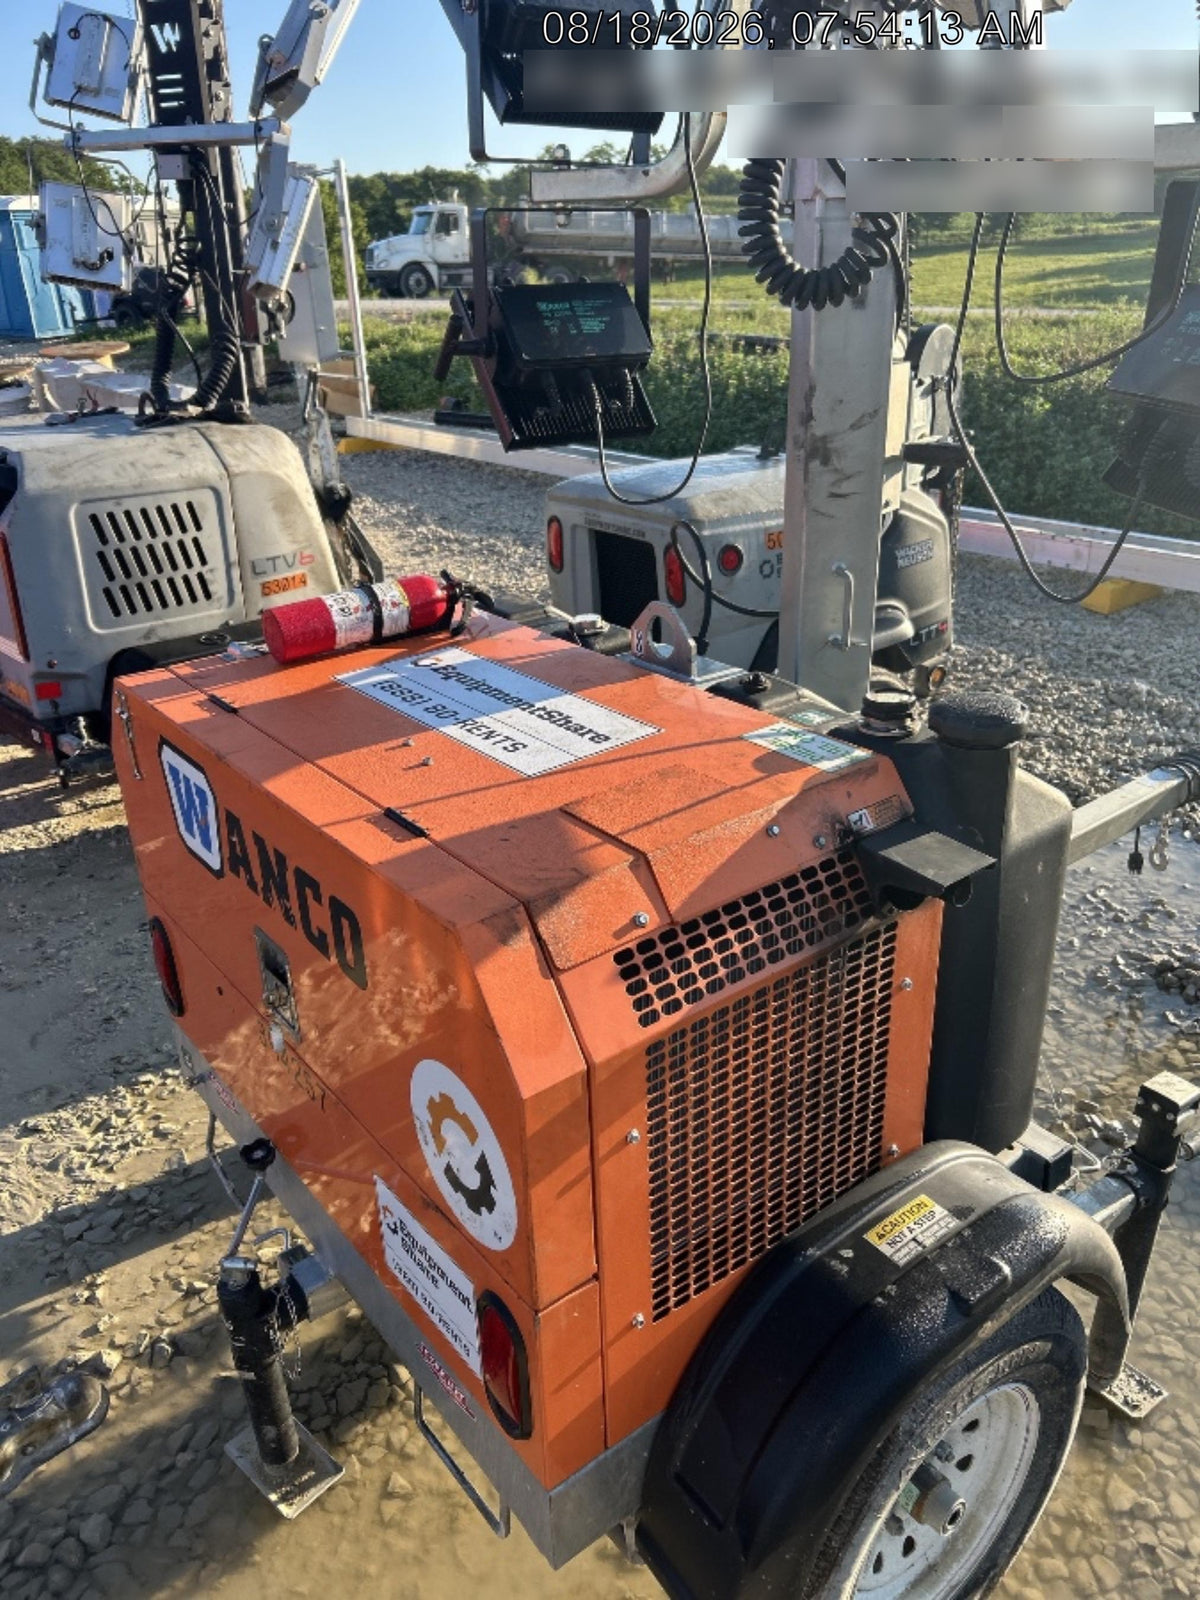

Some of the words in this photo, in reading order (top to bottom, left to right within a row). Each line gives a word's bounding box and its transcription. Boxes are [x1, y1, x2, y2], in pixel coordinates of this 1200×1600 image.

[262, 572, 307, 597] 53014
[430, 663, 612, 745] EquipmentShare
[881, 1200, 929, 1235] CAUTION
[886, 1228, 908, 1249] NOT
[906, 1225, 916, 1235] A
[913, 1209, 937, 1229] STEP
